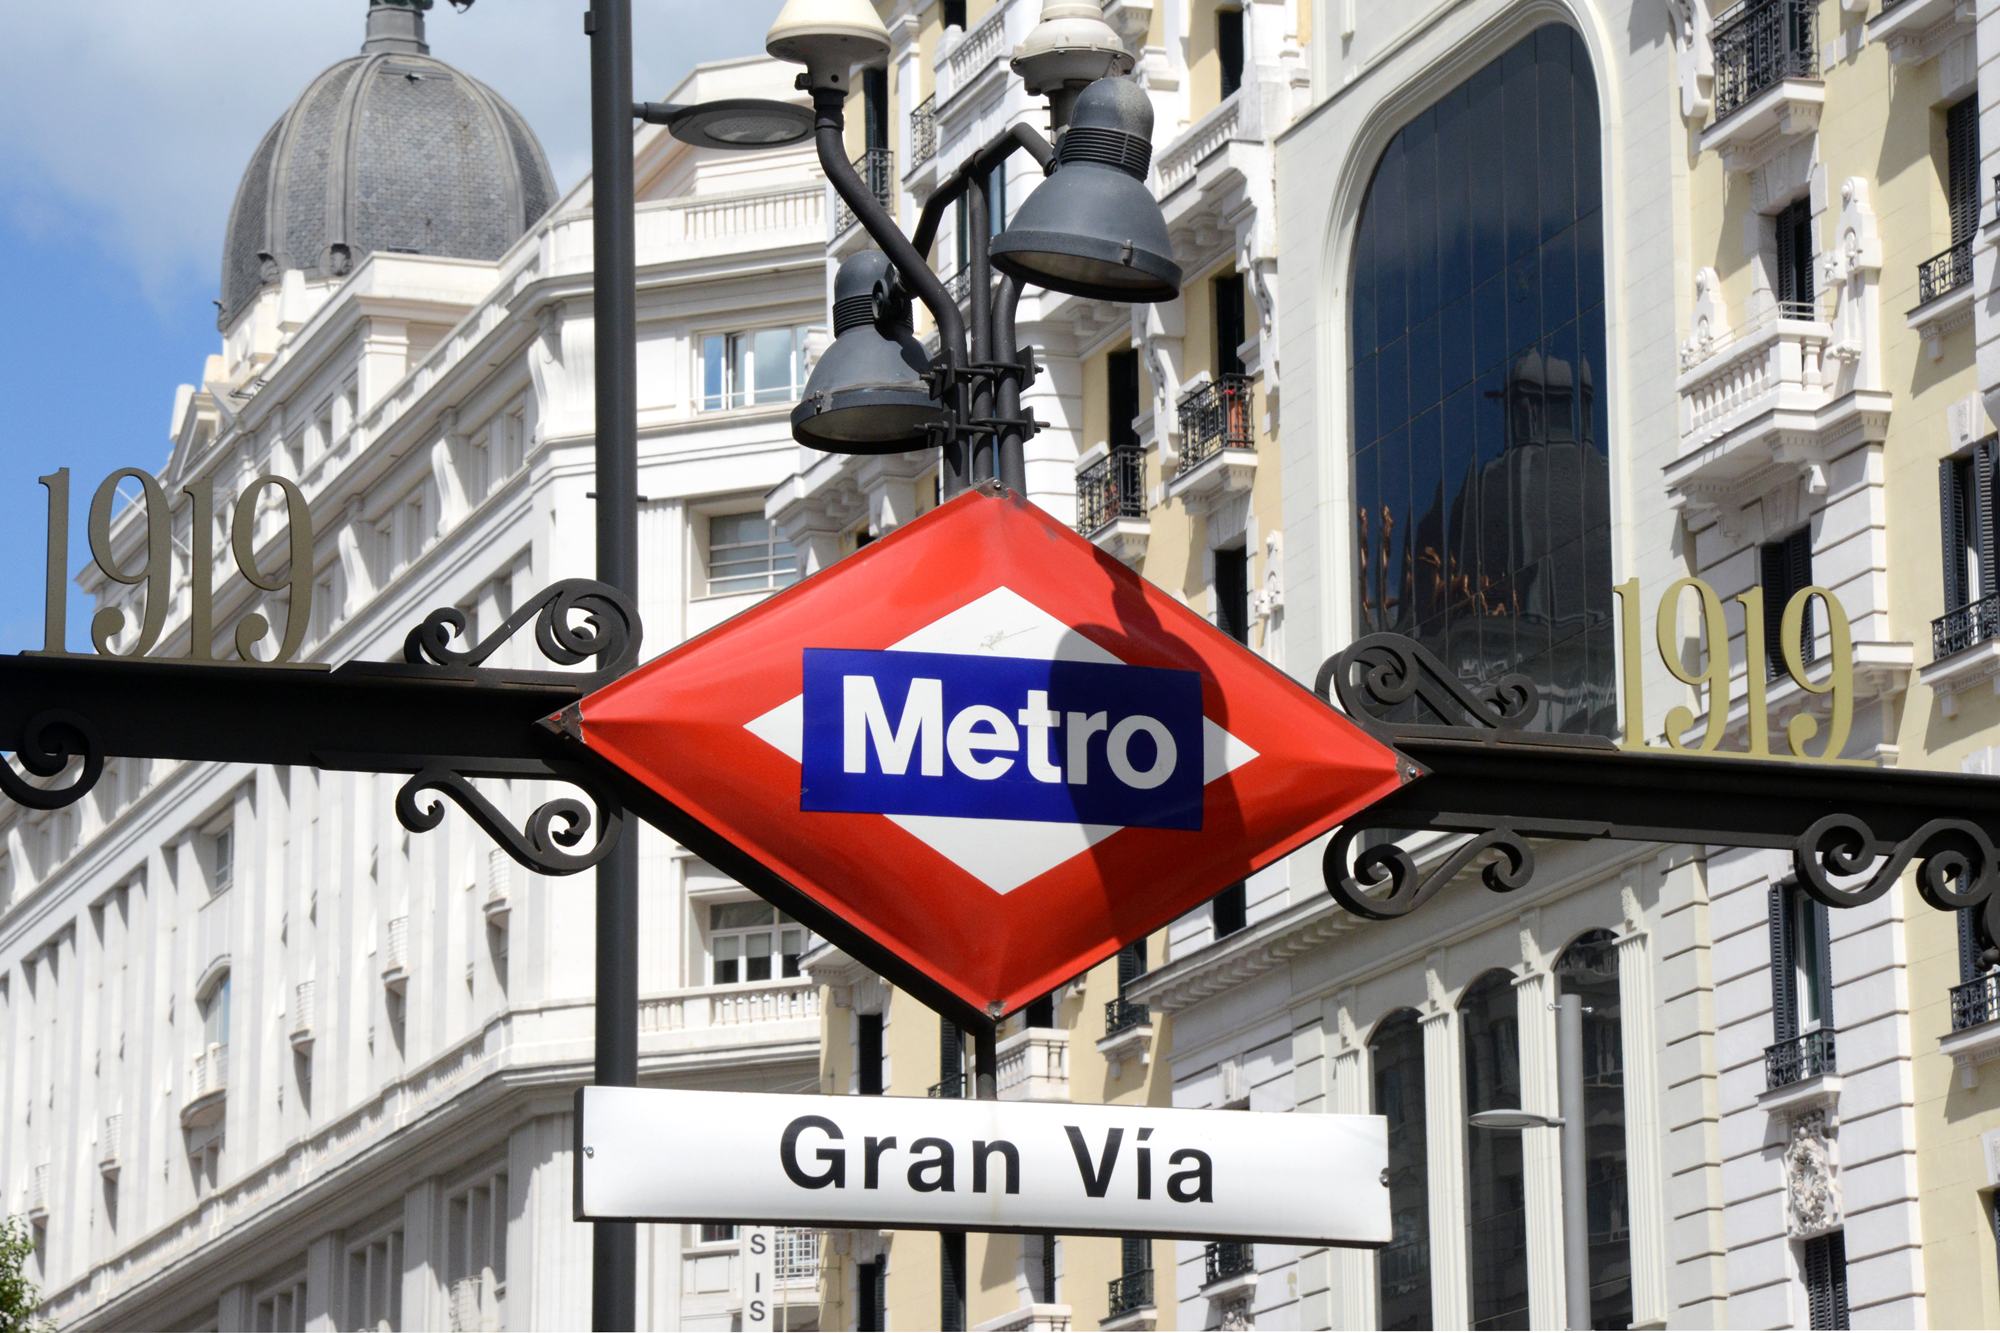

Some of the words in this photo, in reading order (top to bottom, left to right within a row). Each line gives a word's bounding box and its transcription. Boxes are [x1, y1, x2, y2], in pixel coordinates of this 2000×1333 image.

[38, 467, 313, 663] 1919
[1613, 577, 1853, 761] 1919
[843, 675, 1177, 789] Metro
[780, 1115, 1021, 1195] Gran
[1064, 1126, 1214, 1203] Vía
[749, 1227, 766, 1321] SIS
